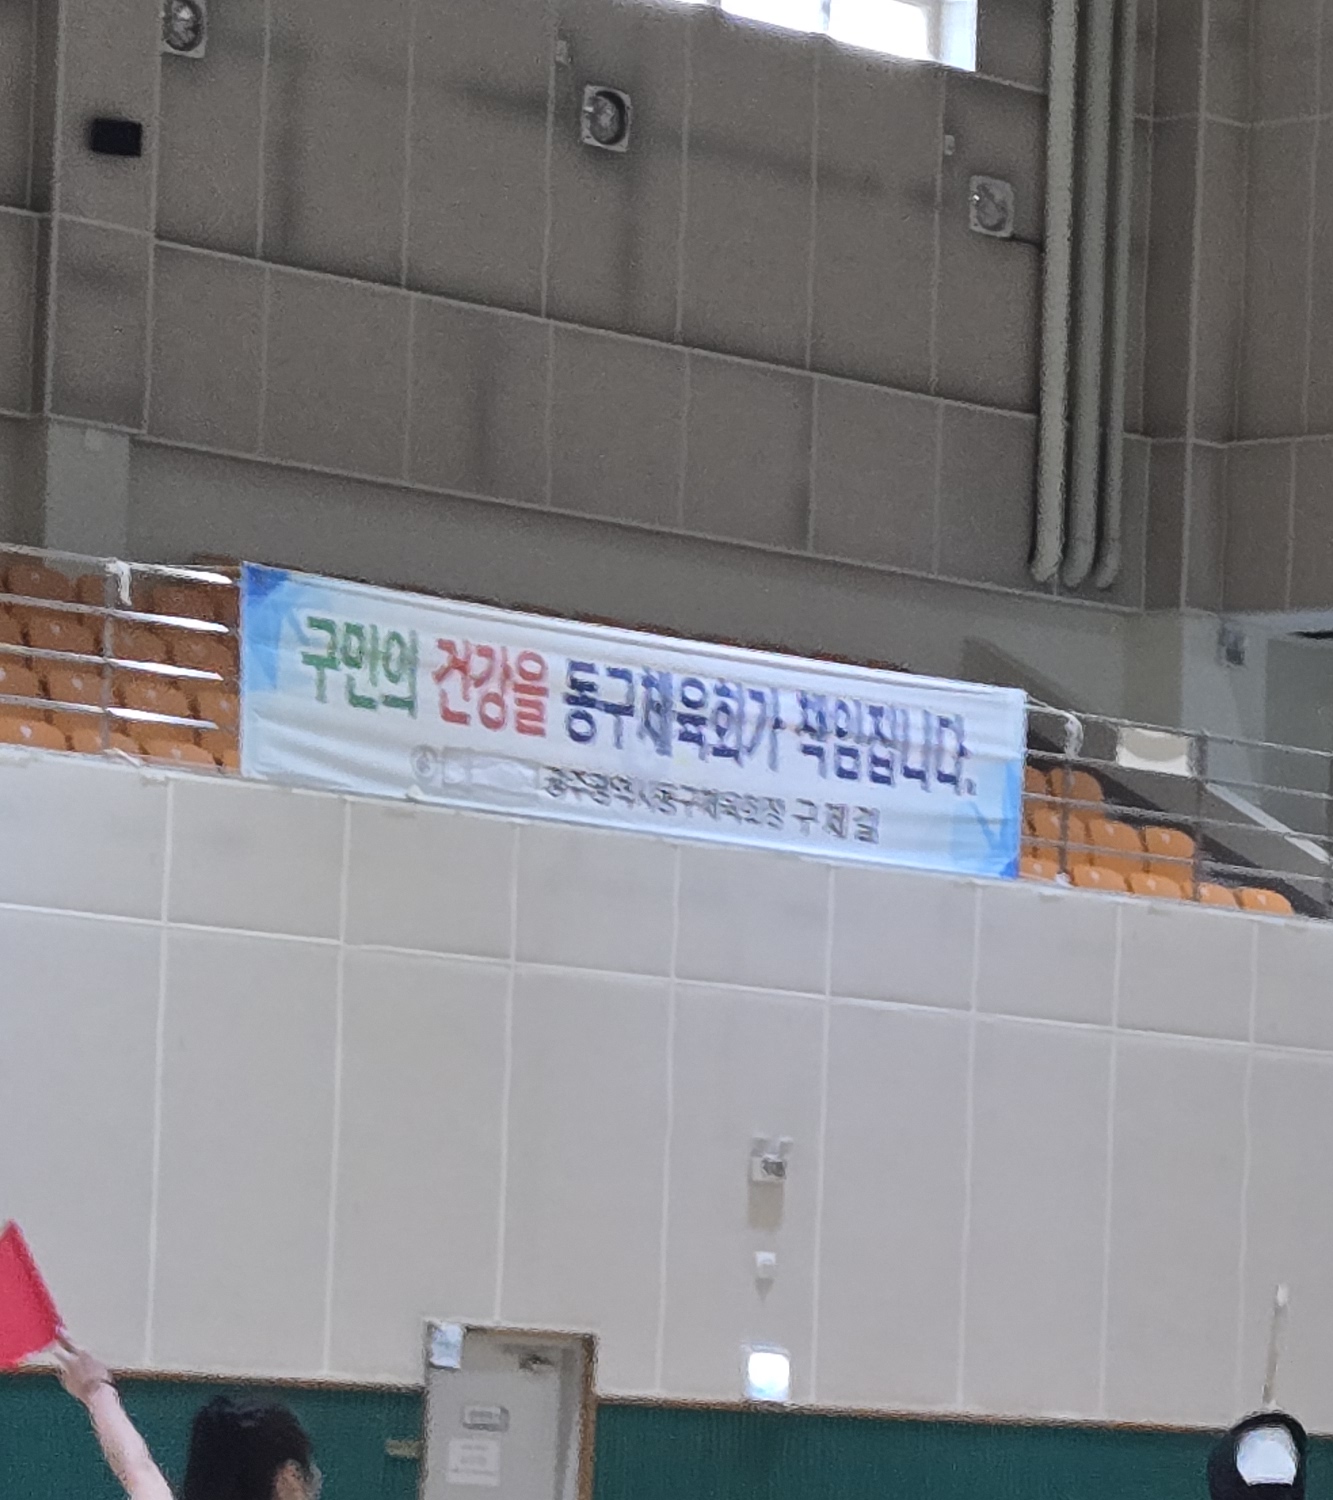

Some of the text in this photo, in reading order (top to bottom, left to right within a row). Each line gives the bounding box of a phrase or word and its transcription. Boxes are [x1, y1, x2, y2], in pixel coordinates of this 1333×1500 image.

[300, 615, 418, 720] 구민의
[431, 637, 550, 739] 건강을
[563, 658, 785, 773] 동구체육회가
